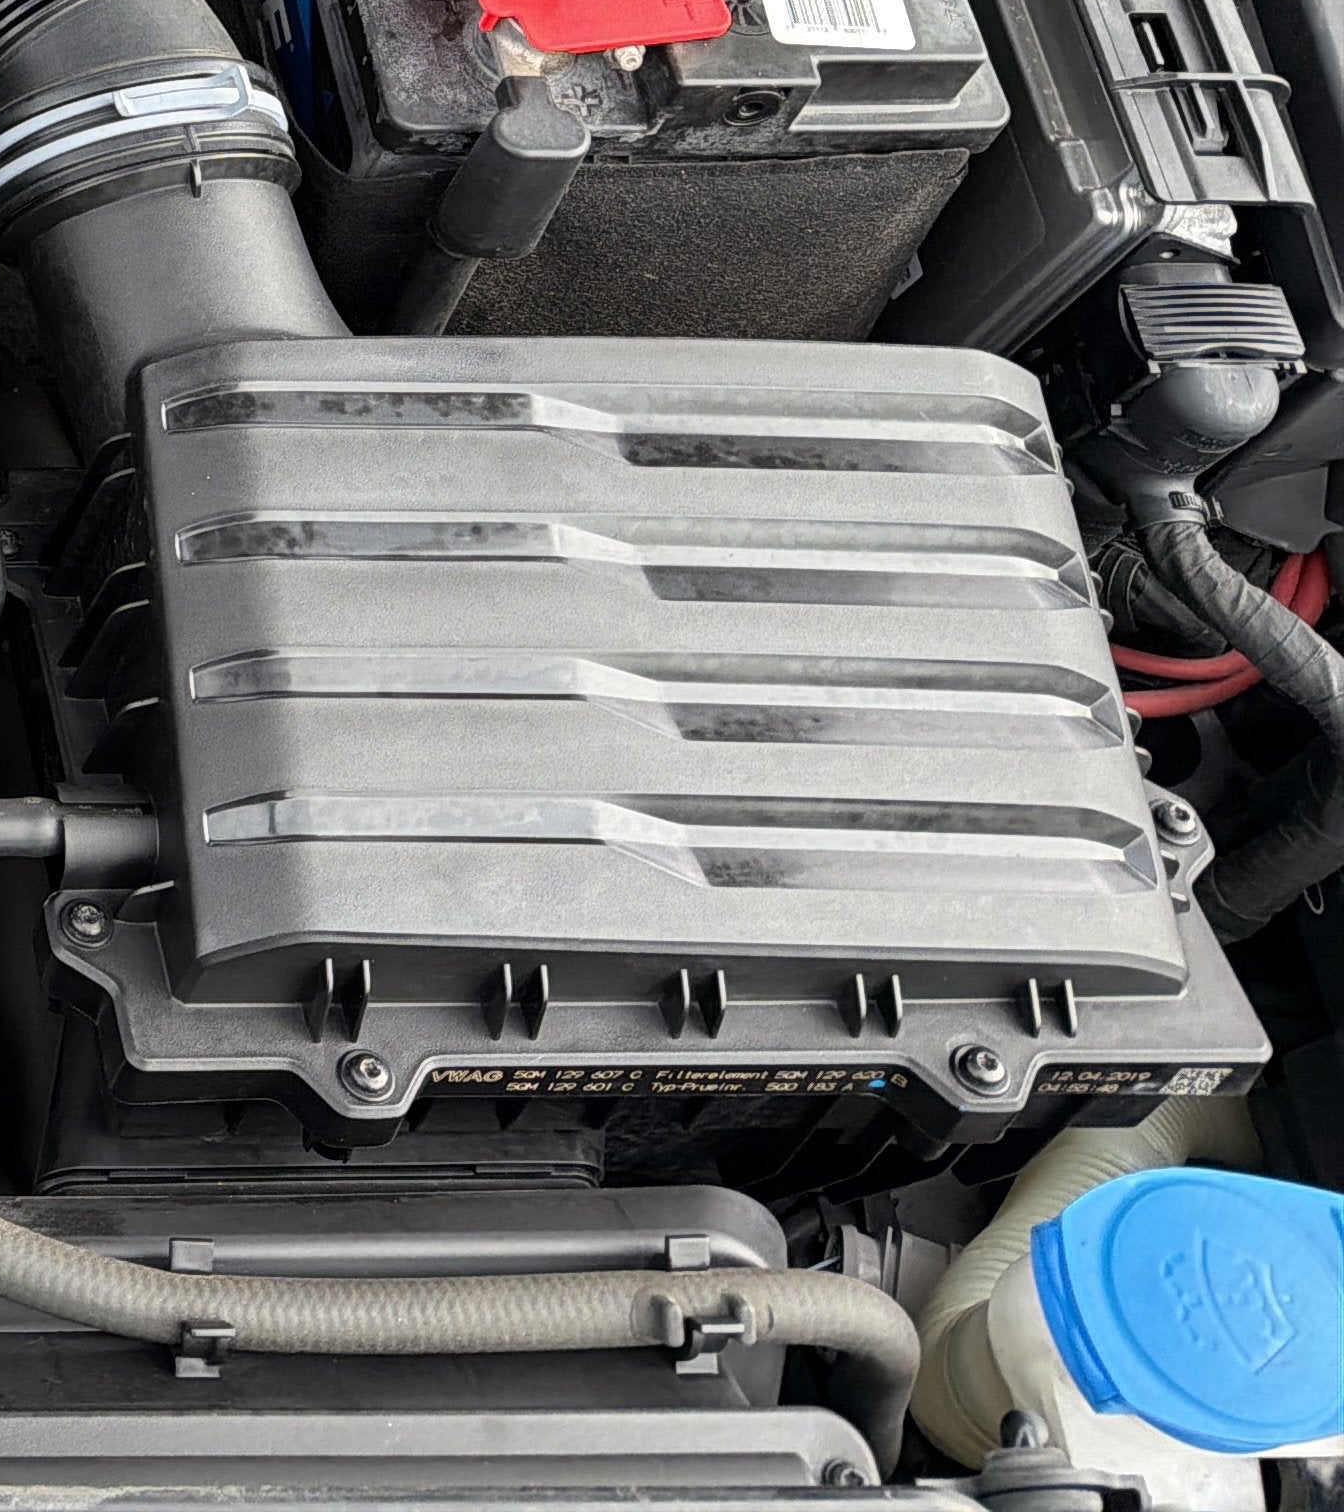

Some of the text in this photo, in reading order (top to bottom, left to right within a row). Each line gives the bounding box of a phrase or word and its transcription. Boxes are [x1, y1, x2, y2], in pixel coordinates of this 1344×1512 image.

[556, 1070, 584, 1079] 129
[591, 1070, 623, 1079] 607
[655, 1070, 768, 1080] Filterelement
[816, 1070, 847, 1080] 129
[547, 1082, 579, 1092] 129
[582, 1082, 612, 1092] 601
